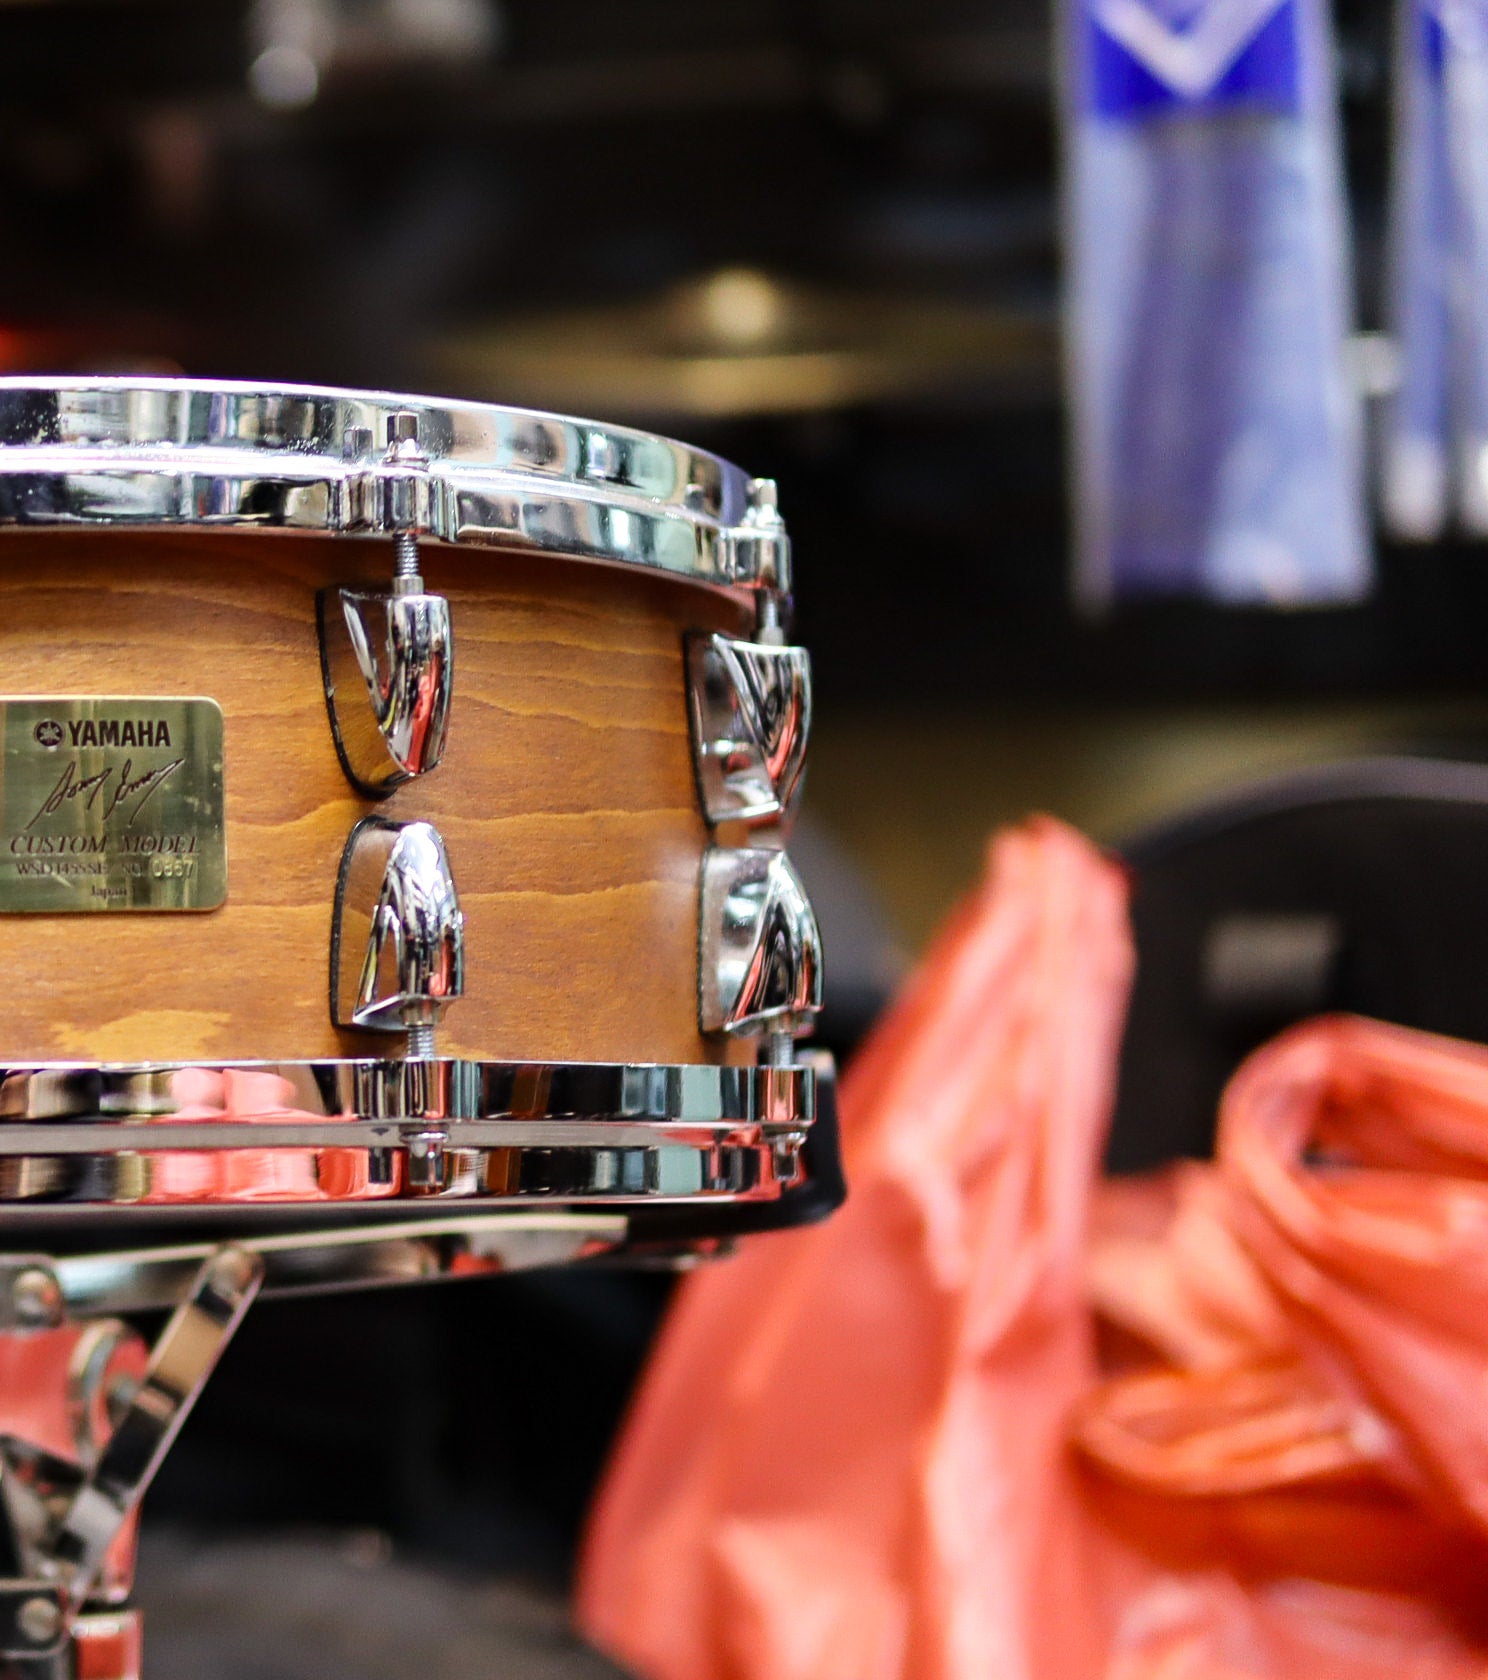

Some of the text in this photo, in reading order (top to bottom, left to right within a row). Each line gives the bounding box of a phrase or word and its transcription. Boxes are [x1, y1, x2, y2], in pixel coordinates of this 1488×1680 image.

[68, 720, 171, 747] YAMAHA
[9, 835, 201, 854] CUSTOM MODEL
[90, 885, 128, 897] Japan
